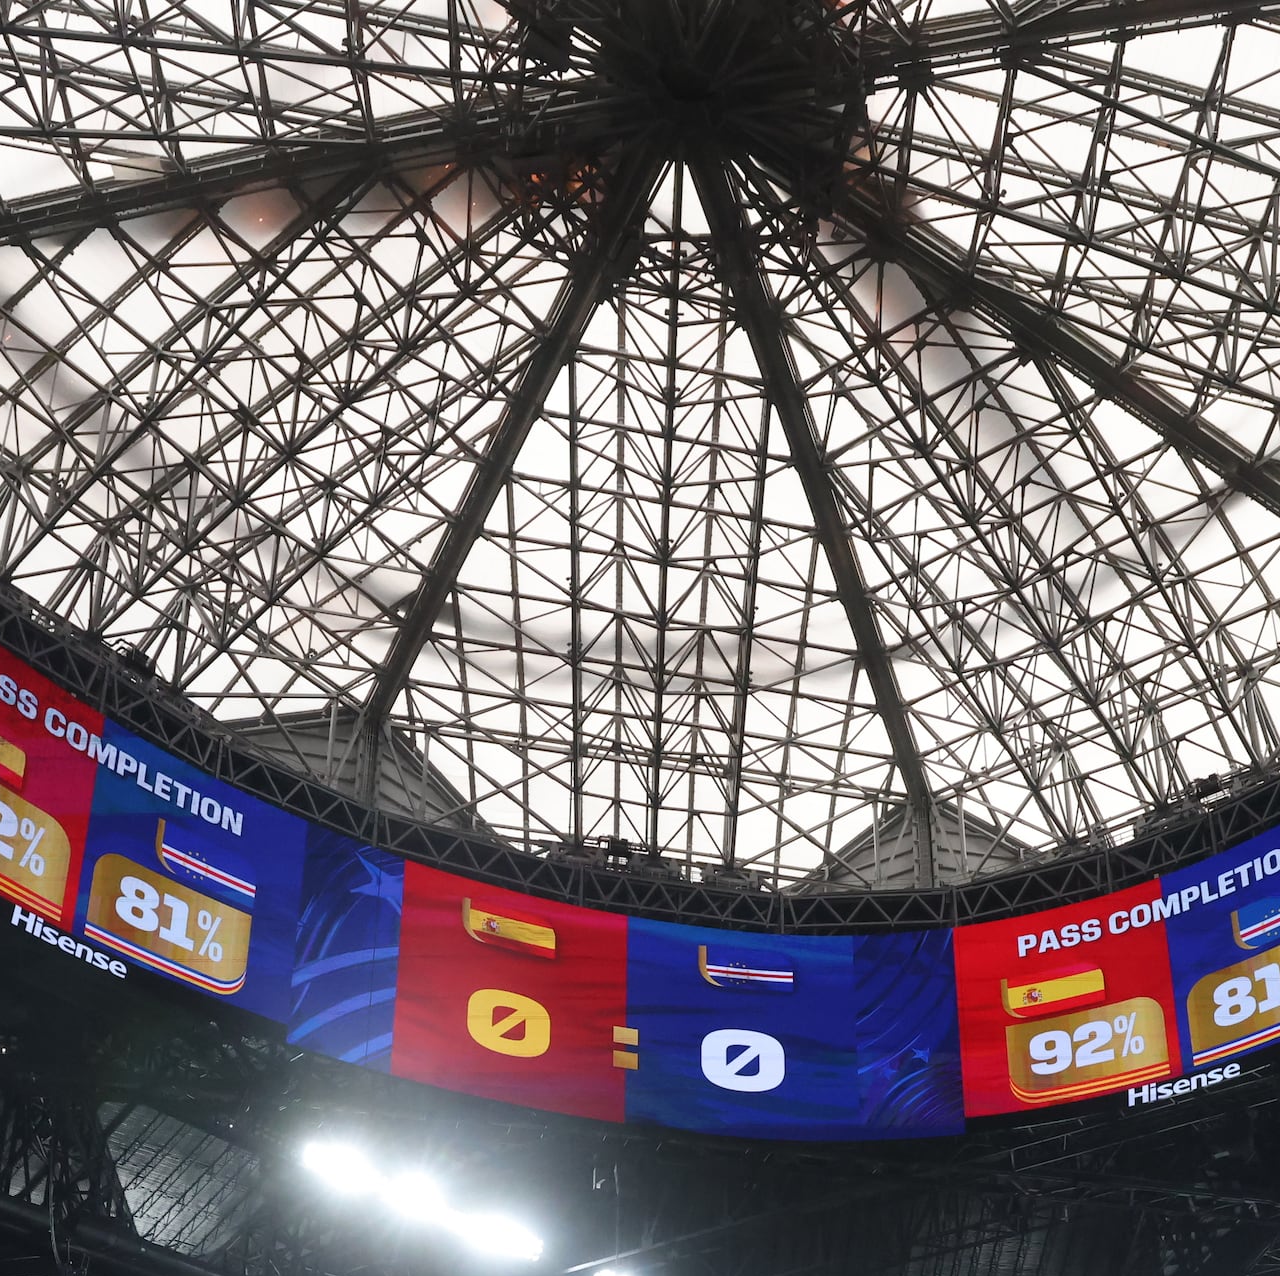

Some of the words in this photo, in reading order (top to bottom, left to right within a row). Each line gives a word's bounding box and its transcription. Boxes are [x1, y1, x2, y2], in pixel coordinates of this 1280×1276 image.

[44, 707, 244, 837] COMPLETION
[10, 905, 128, 980] Hisense
[115, 875, 224, 964] 81%
[1018, 918, 1102, 958] PASS
[467, 988, 551, 1059] 0
[1028, 1010, 1145, 1076] 92%
[700, 1028, 787, 1093] 0
[1127, 1061, 1241, 1107] Hisense
